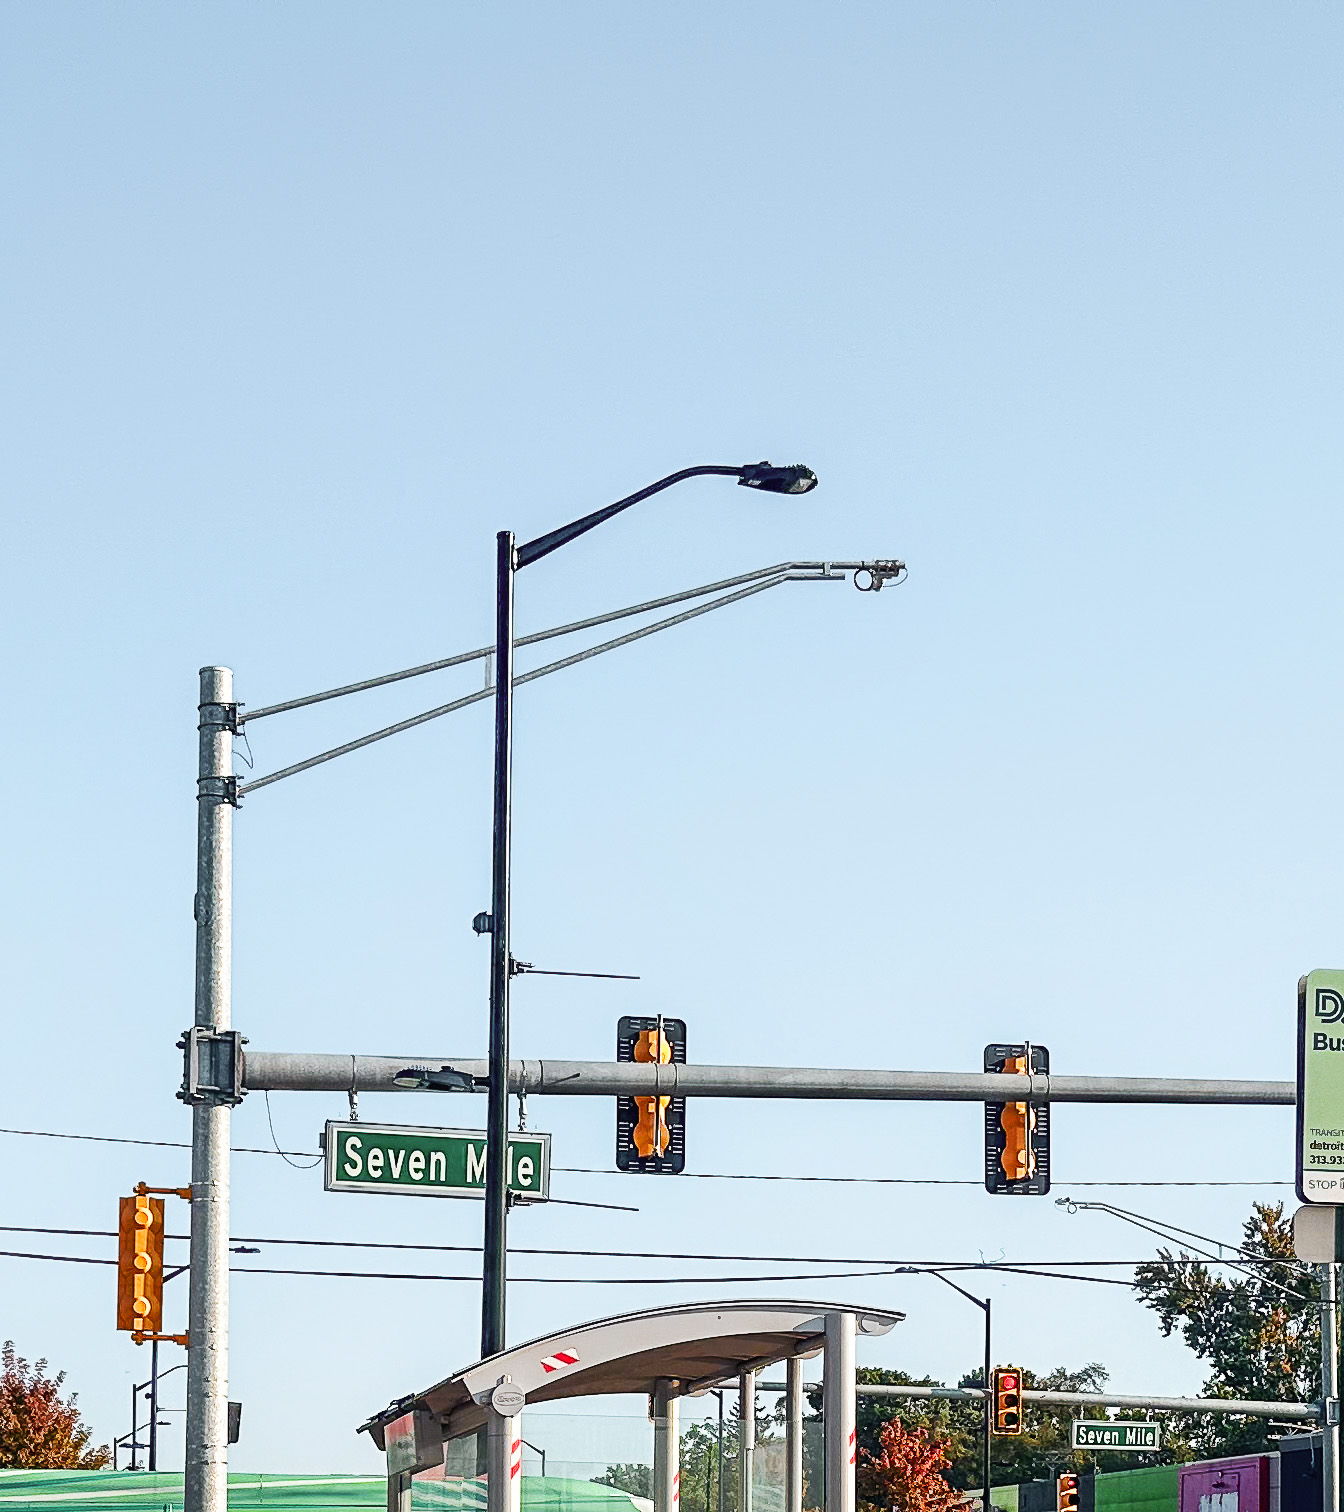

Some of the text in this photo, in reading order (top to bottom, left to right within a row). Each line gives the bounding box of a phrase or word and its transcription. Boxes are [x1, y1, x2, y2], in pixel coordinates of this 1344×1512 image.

[1309, 1128, 1344, 1138] TRANSIT
[343, 1135, 535, 1187] Seven Mle
[1308, 1179, 1338, 1190] STOP
[1078, 1426, 1154, 1446] Seven Mile
